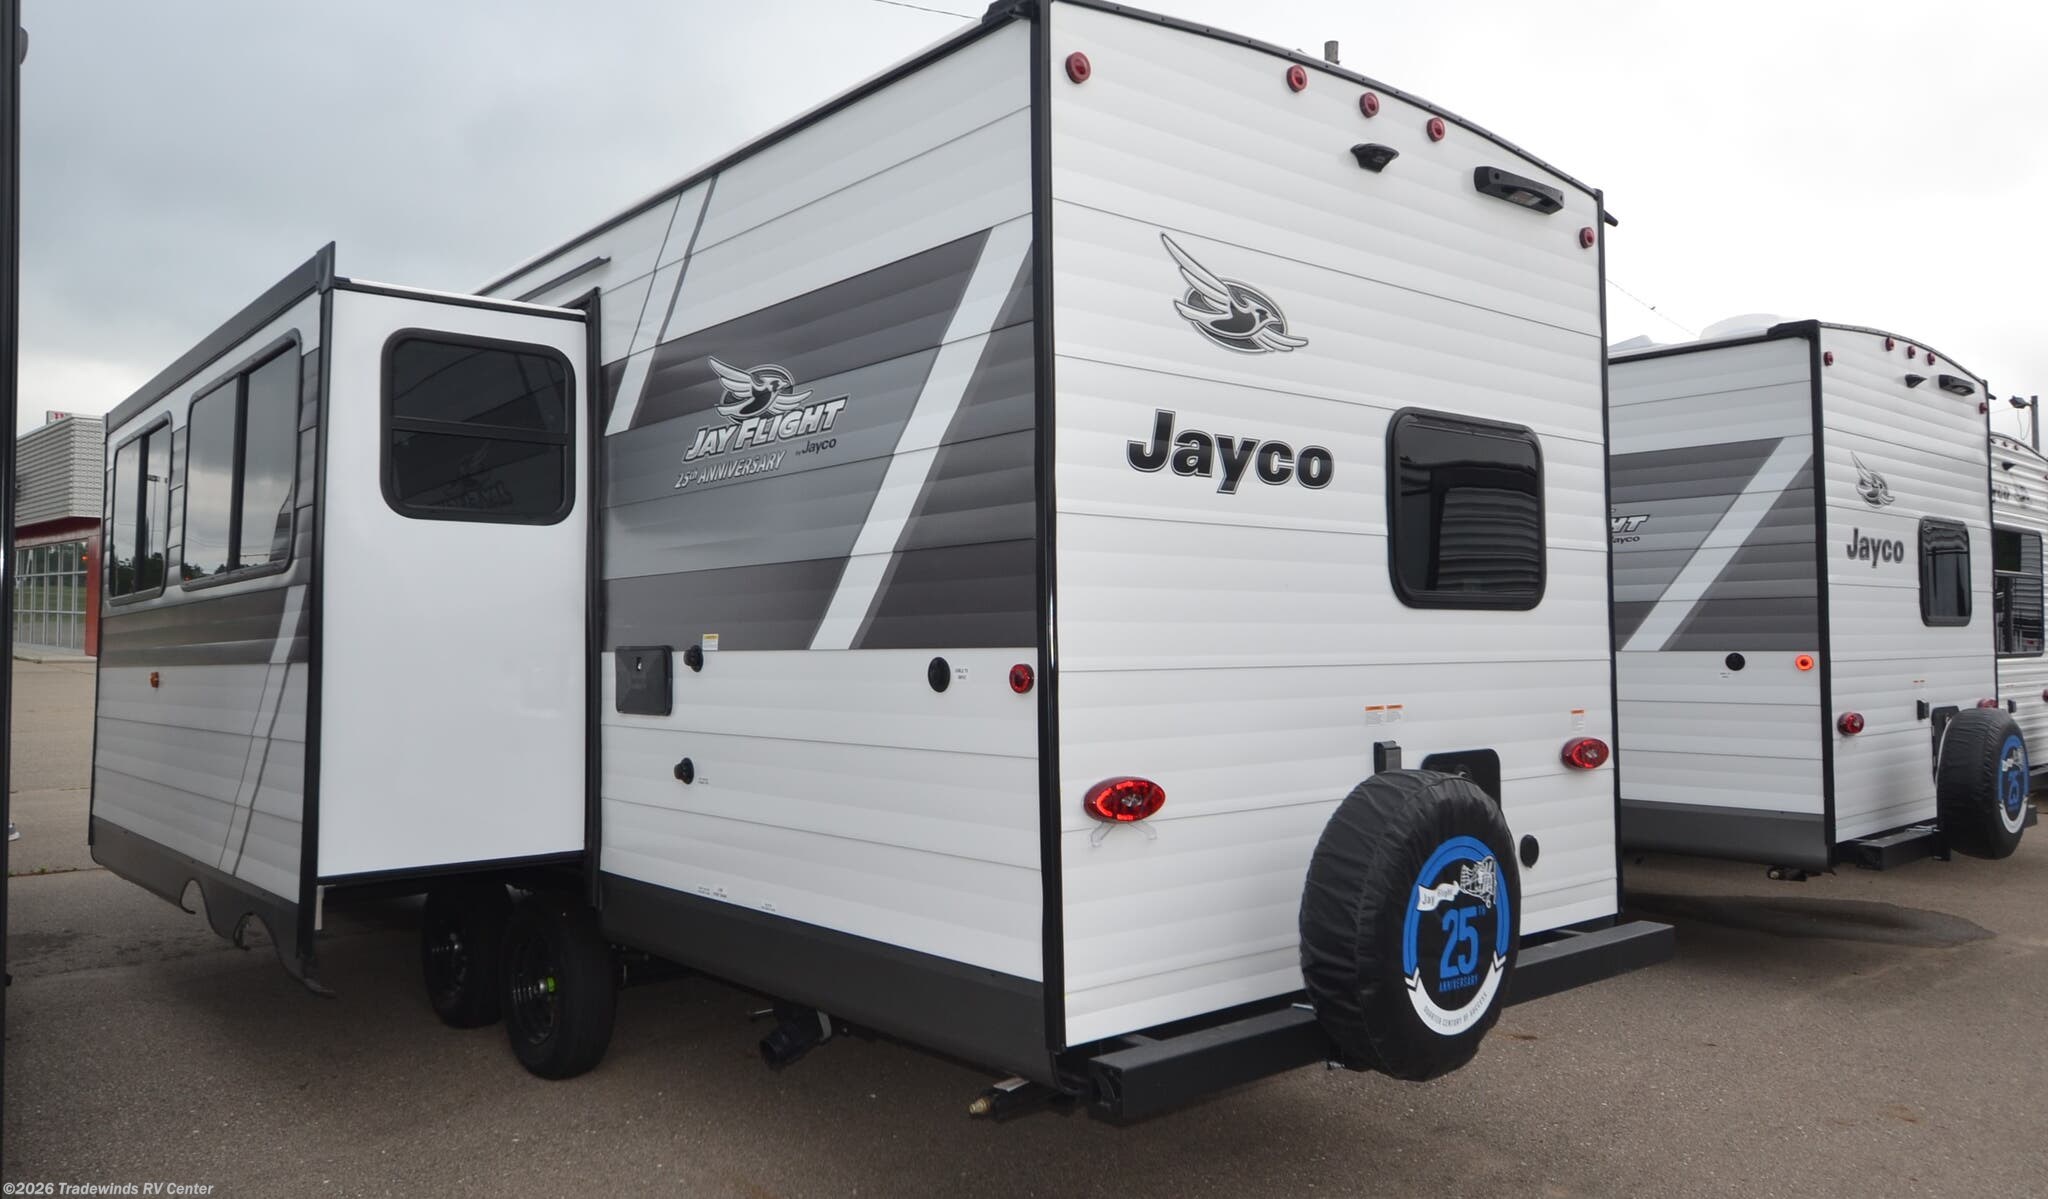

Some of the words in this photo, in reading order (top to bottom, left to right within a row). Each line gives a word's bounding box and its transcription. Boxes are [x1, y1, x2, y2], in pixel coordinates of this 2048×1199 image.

[683, 424, 739, 462] JAY
[733, 395, 848, 450] FLIGHT
[801, 437, 837, 455] Jayco
[1126, 408, 1334, 494] Jayco
[697, 451, 786, 484] ANNIVERSARY
[1611, 536, 1640, 544] ayco
[1846, 527, 1904, 569] Jayco
[1439, 973, 1479, 992] ANNIVERSARY
